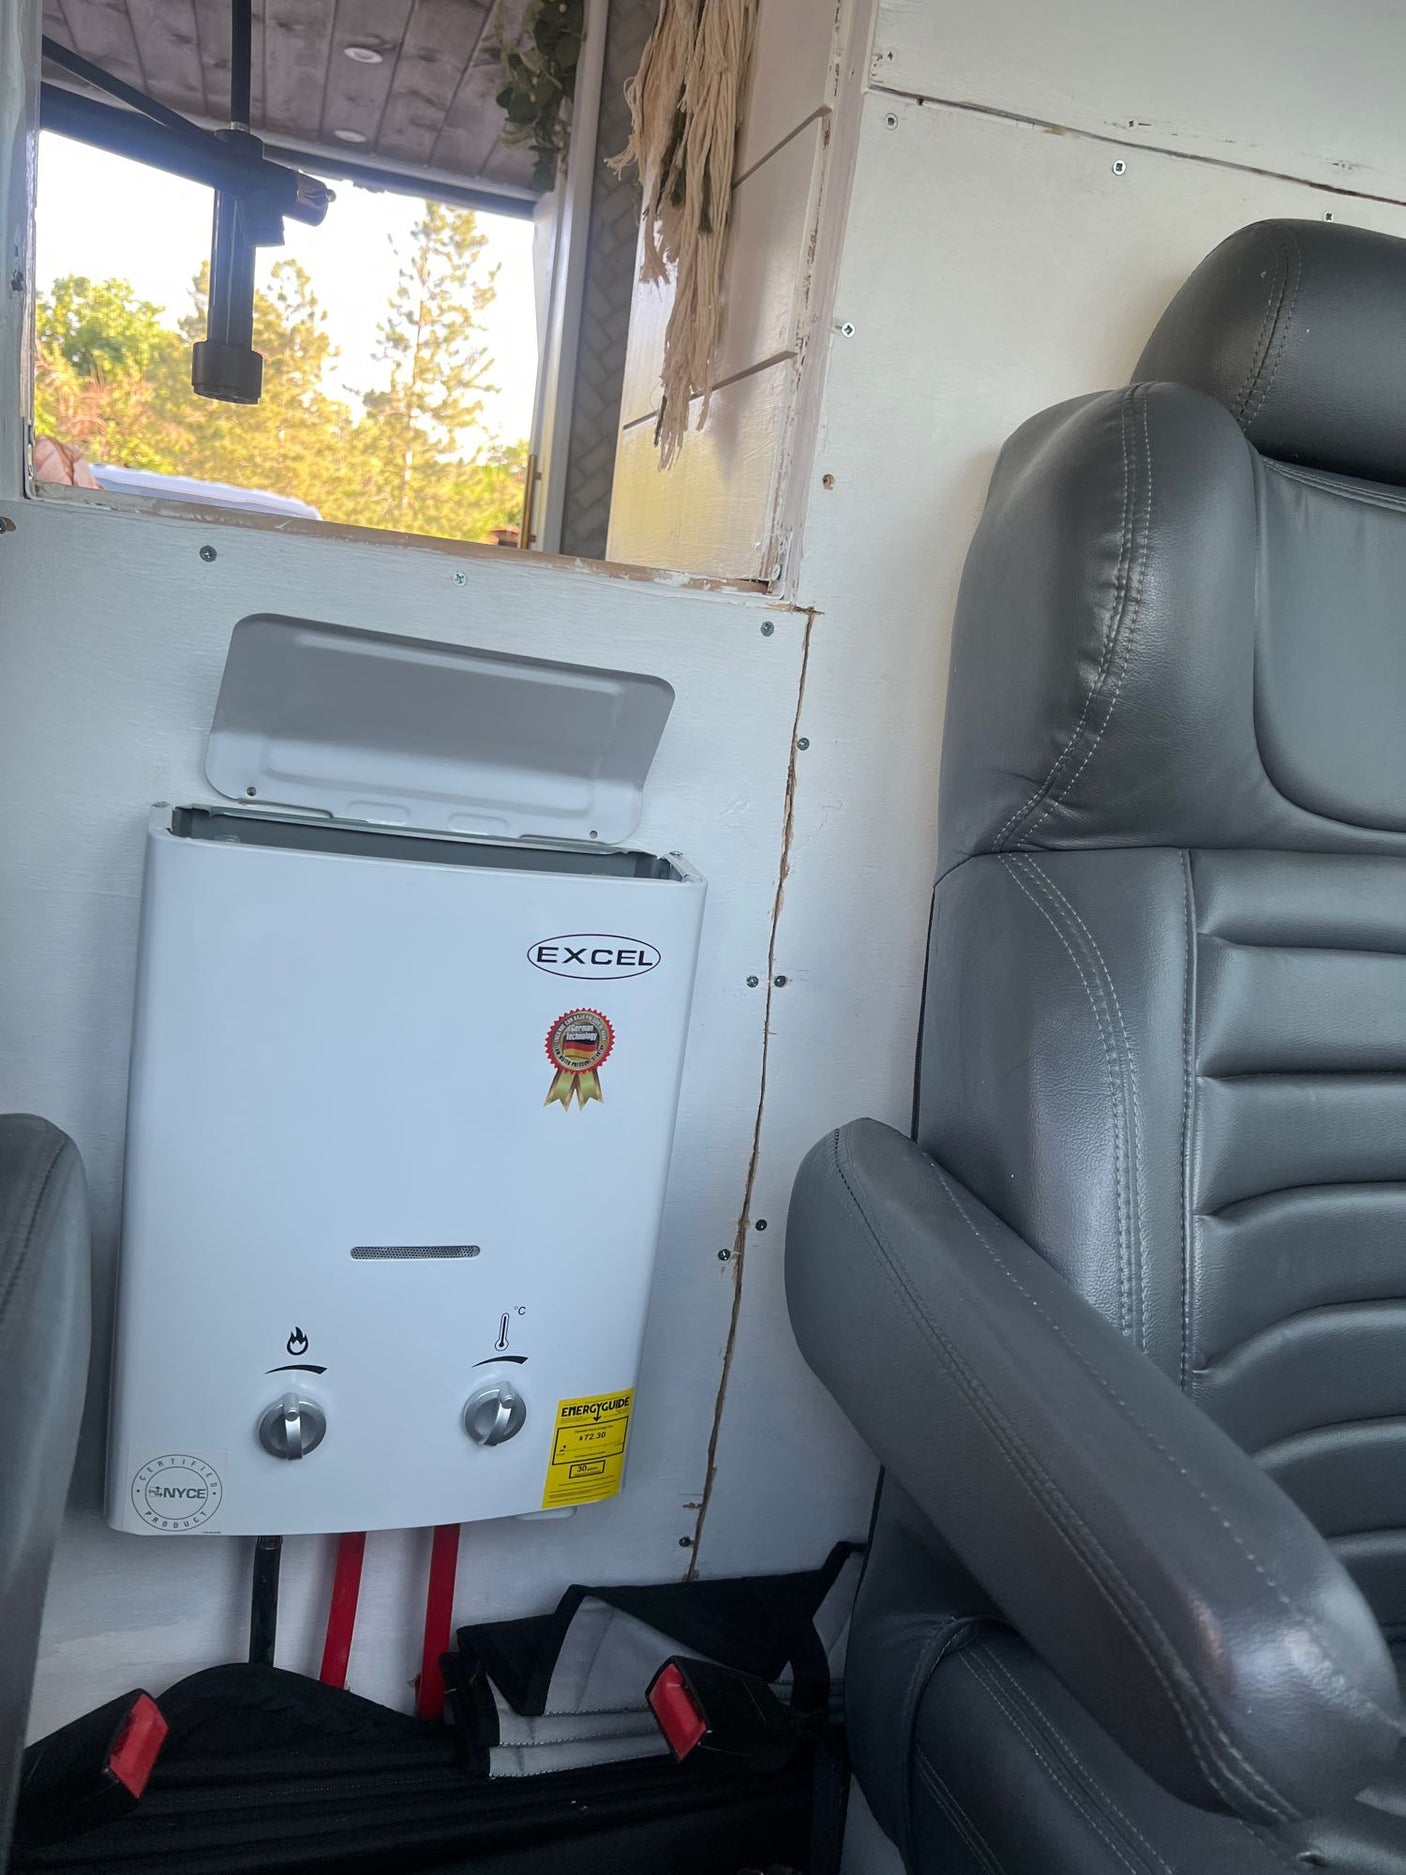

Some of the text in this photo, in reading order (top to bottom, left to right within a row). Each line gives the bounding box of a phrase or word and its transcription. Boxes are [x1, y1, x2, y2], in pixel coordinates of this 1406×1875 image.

[536, 946, 653, 966] EXCEL
[561, 1396, 631, 1419] ENERGYGUIDE
[139, 1458, 218, 1488] CERTIFIED
[163, 1487, 206, 1499] NYCE
[145, 1511, 207, 1528] PRODUCT
